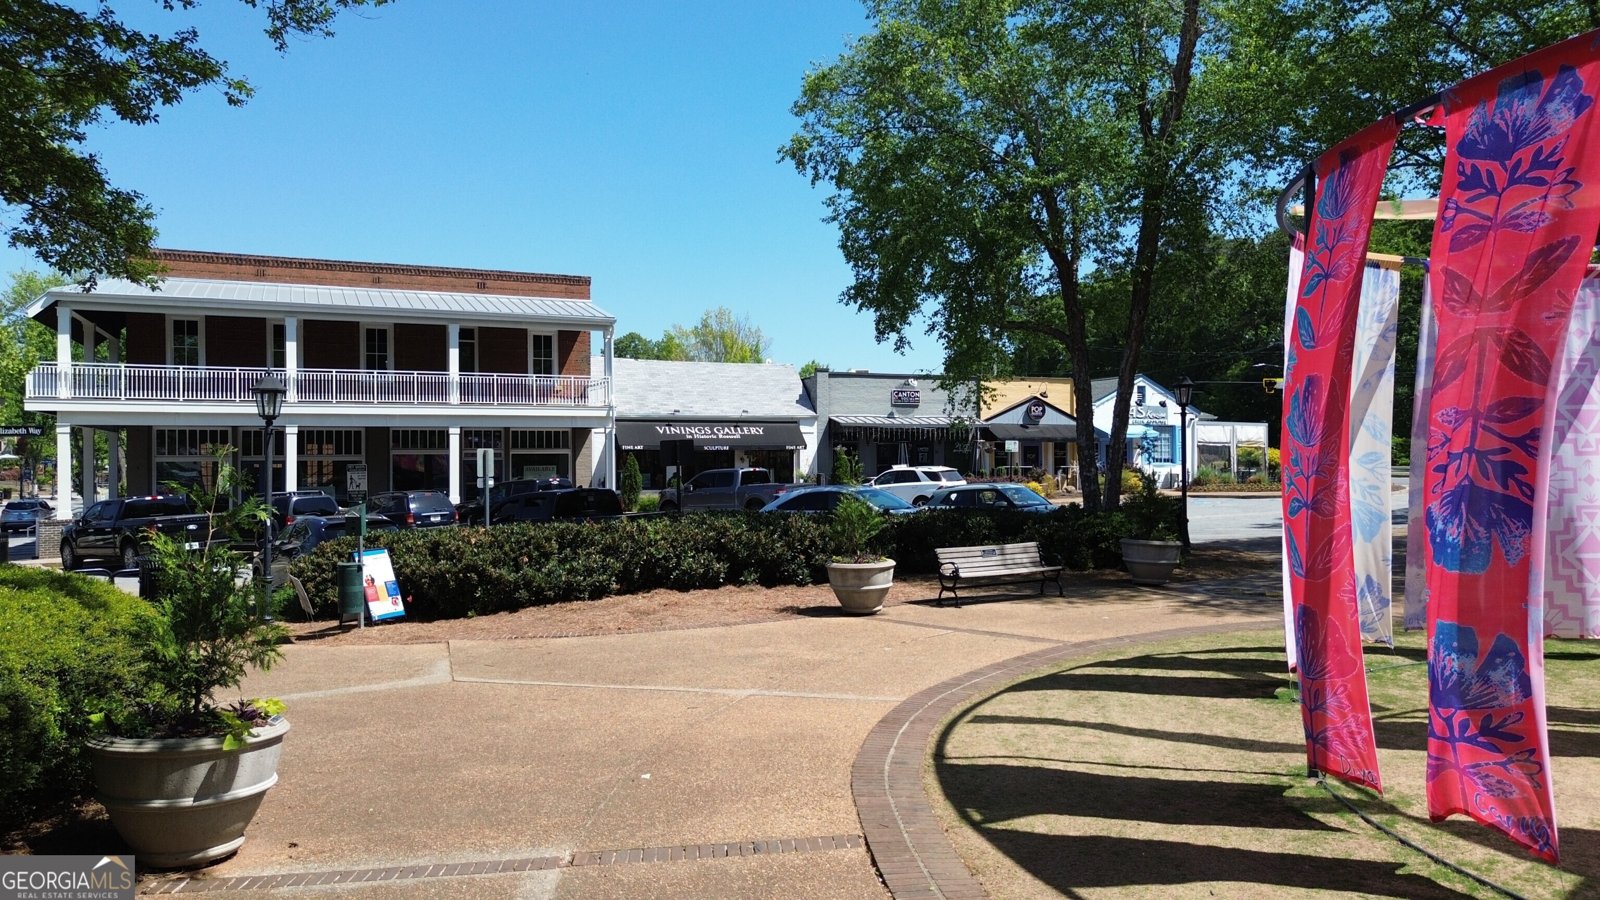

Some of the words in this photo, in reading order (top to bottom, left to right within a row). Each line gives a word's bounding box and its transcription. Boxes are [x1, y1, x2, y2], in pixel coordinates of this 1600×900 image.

[28, 427, 42, 435] Way
[655, 426, 711, 435] VININGS
[713, 426, 764, 435] GALLERY
